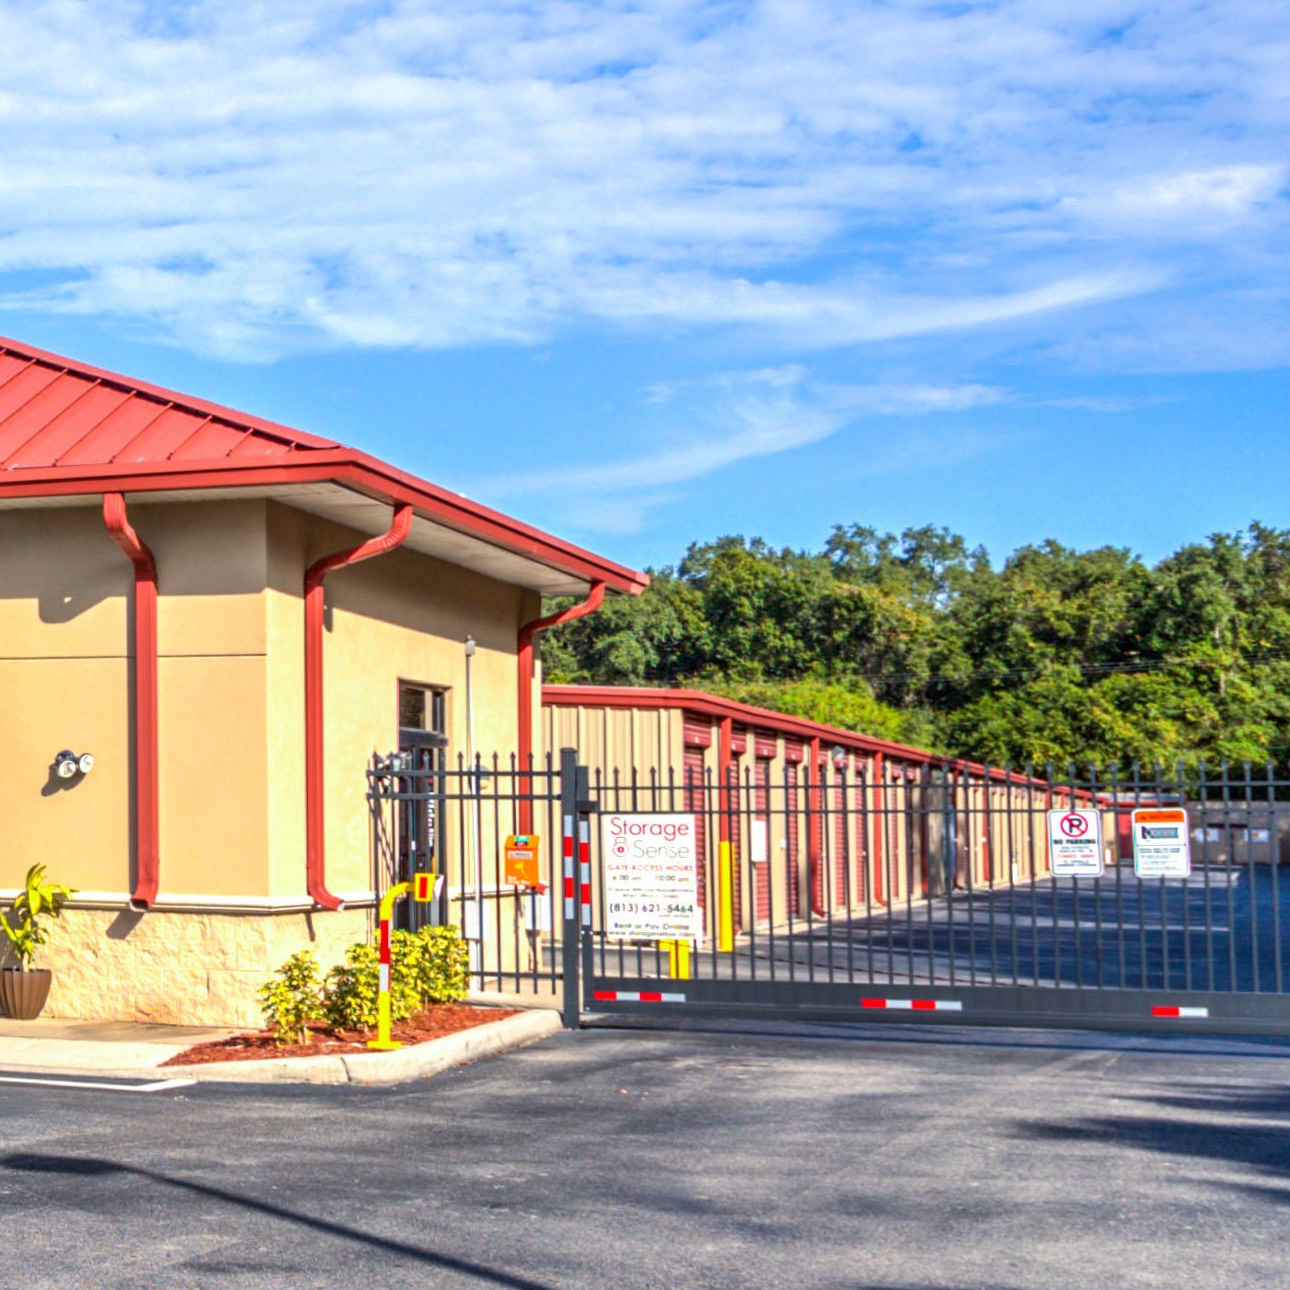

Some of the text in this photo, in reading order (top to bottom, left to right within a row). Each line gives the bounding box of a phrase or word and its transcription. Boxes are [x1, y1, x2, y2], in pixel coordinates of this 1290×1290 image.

[610, 816, 689, 842] Storage
[633, 839, 689, 859] Sense
[609, 903, 694, 914] (813) 621-5464
